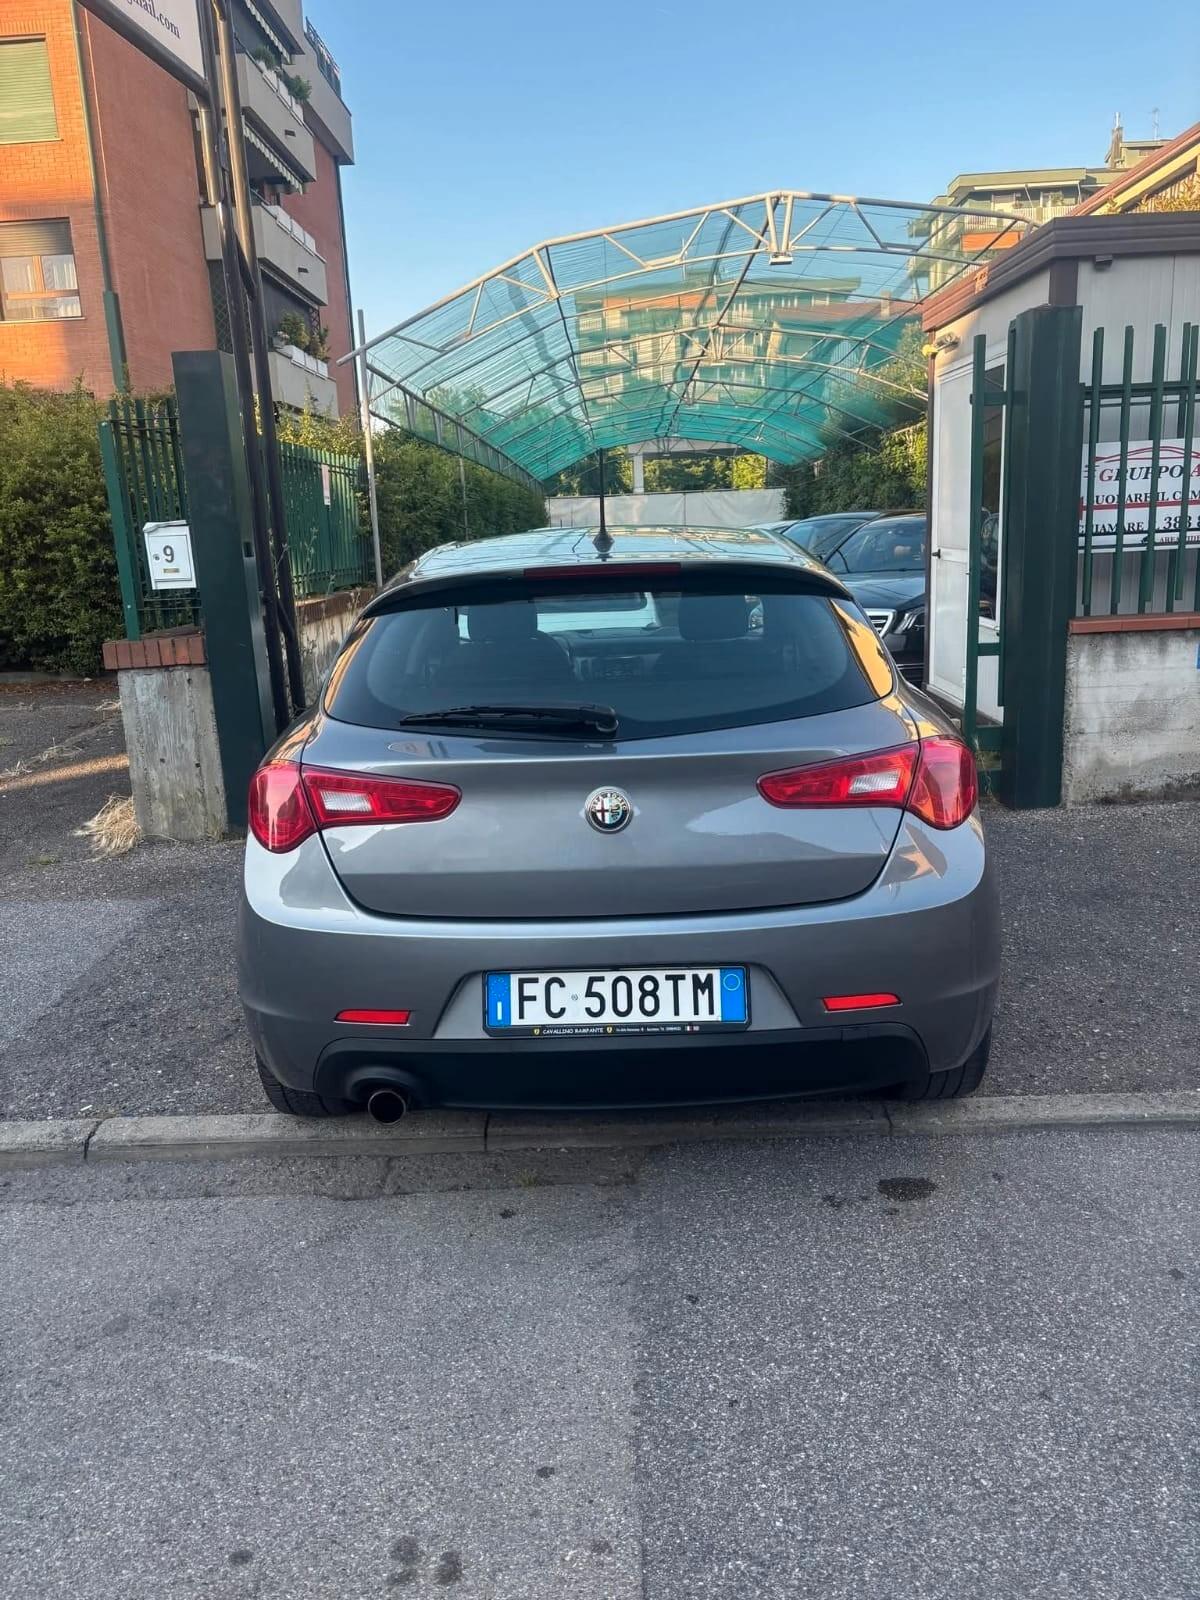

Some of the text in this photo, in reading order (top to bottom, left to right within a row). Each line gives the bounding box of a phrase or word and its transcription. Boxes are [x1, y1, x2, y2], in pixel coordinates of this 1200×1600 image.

[127, 0, 181, 39] mail.com
[162, 544, 175, 563] 9
[518, 976, 566, 1019] FC
[584, 973, 715, 1018] 508TM
